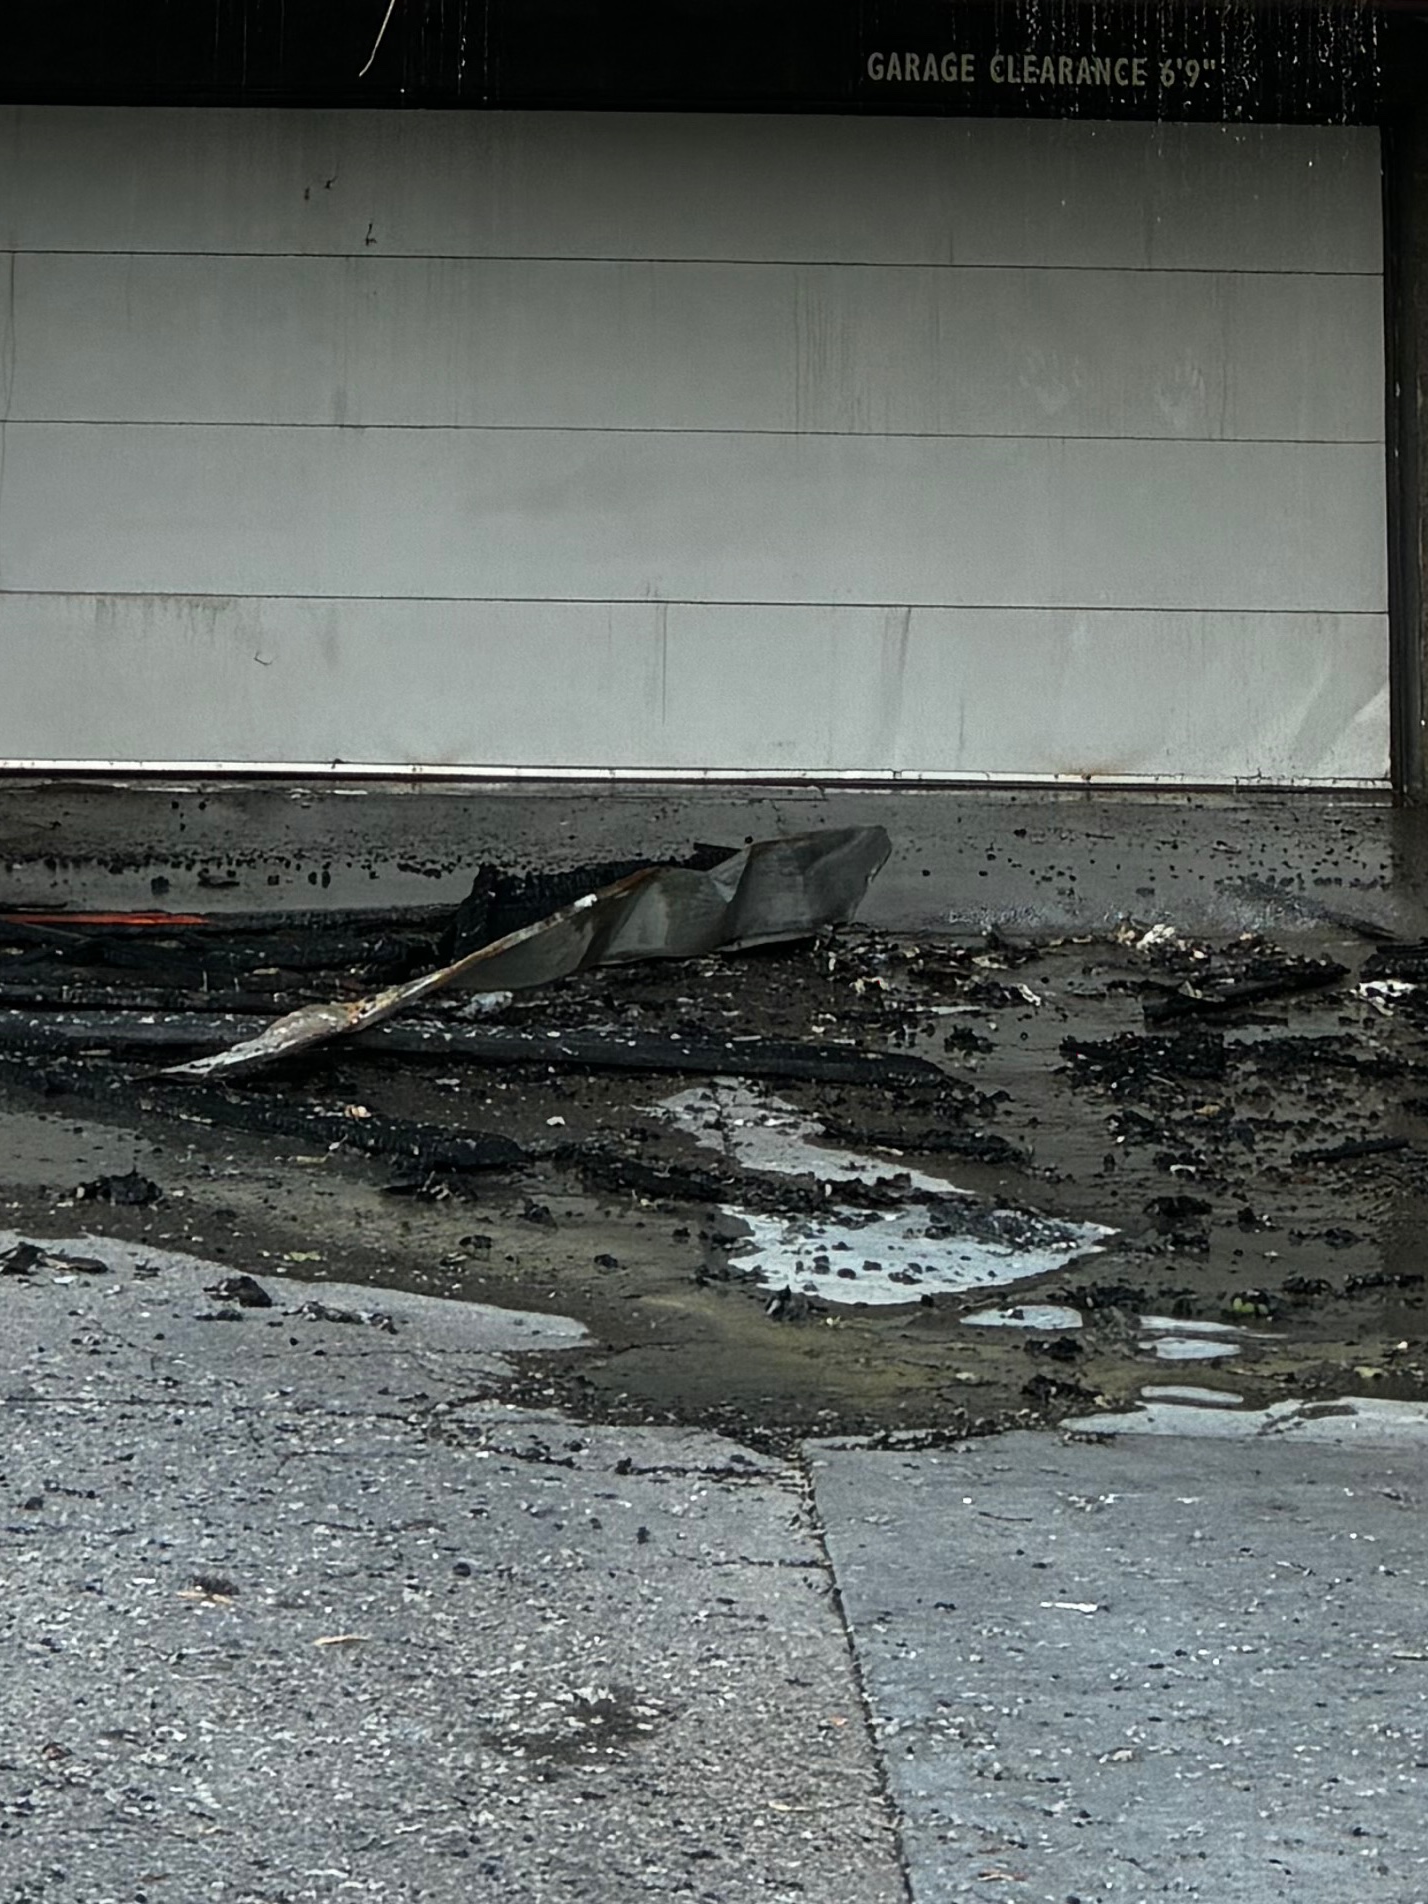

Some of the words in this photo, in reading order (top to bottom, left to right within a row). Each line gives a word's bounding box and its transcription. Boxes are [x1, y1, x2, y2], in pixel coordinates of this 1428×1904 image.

[867, 51, 975, 83] GARAGE
[990, 53, 1147, 86] CLEARANCE
[1160, 58, 1216, 88] 6'9"
